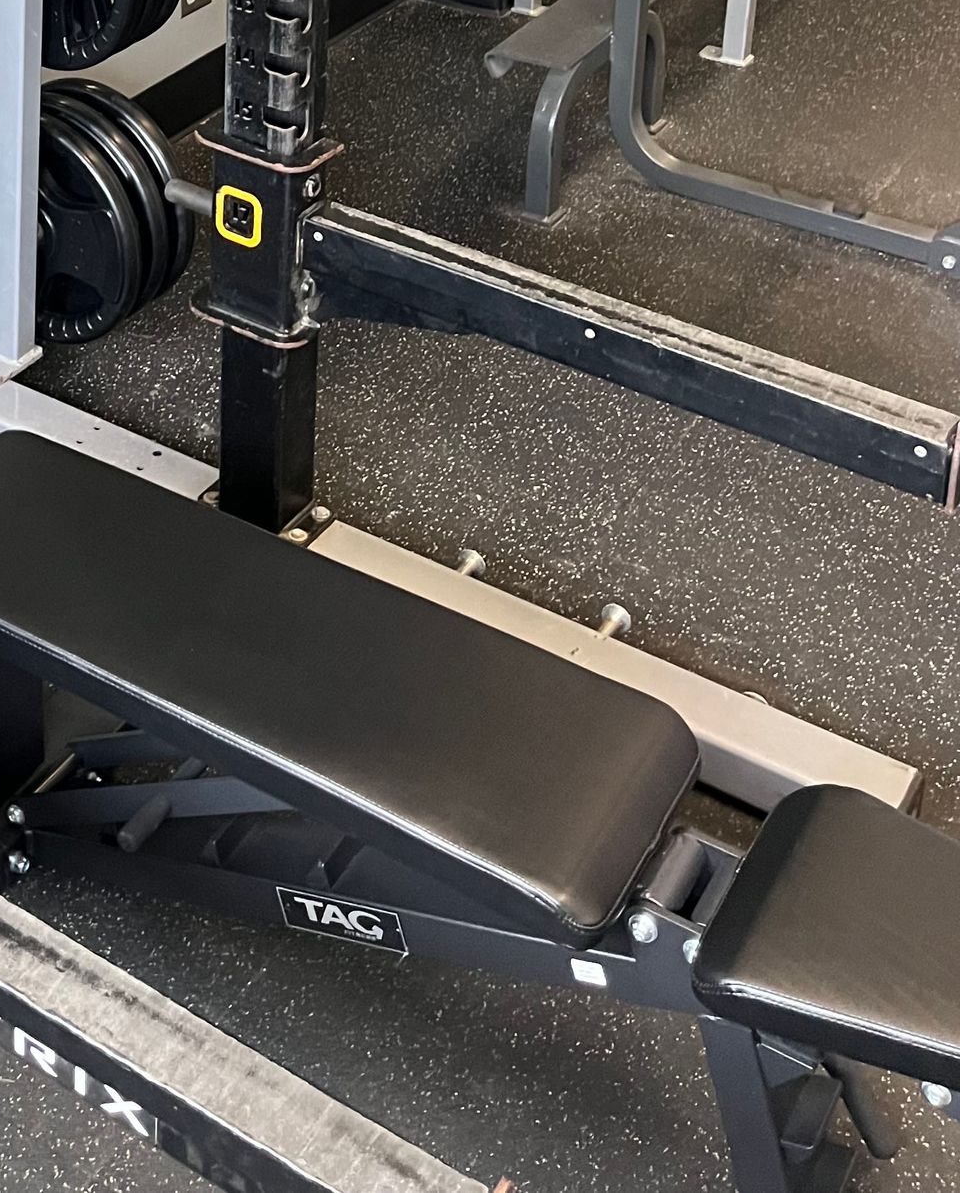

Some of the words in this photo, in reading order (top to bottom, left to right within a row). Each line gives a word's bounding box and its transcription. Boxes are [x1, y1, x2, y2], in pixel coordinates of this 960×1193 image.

[235, 46, 255, 68] 14
[234, 98, 252, 120] 15
[232, 202, 250, 224] 17
[293, 896, 384, 940] TAG
